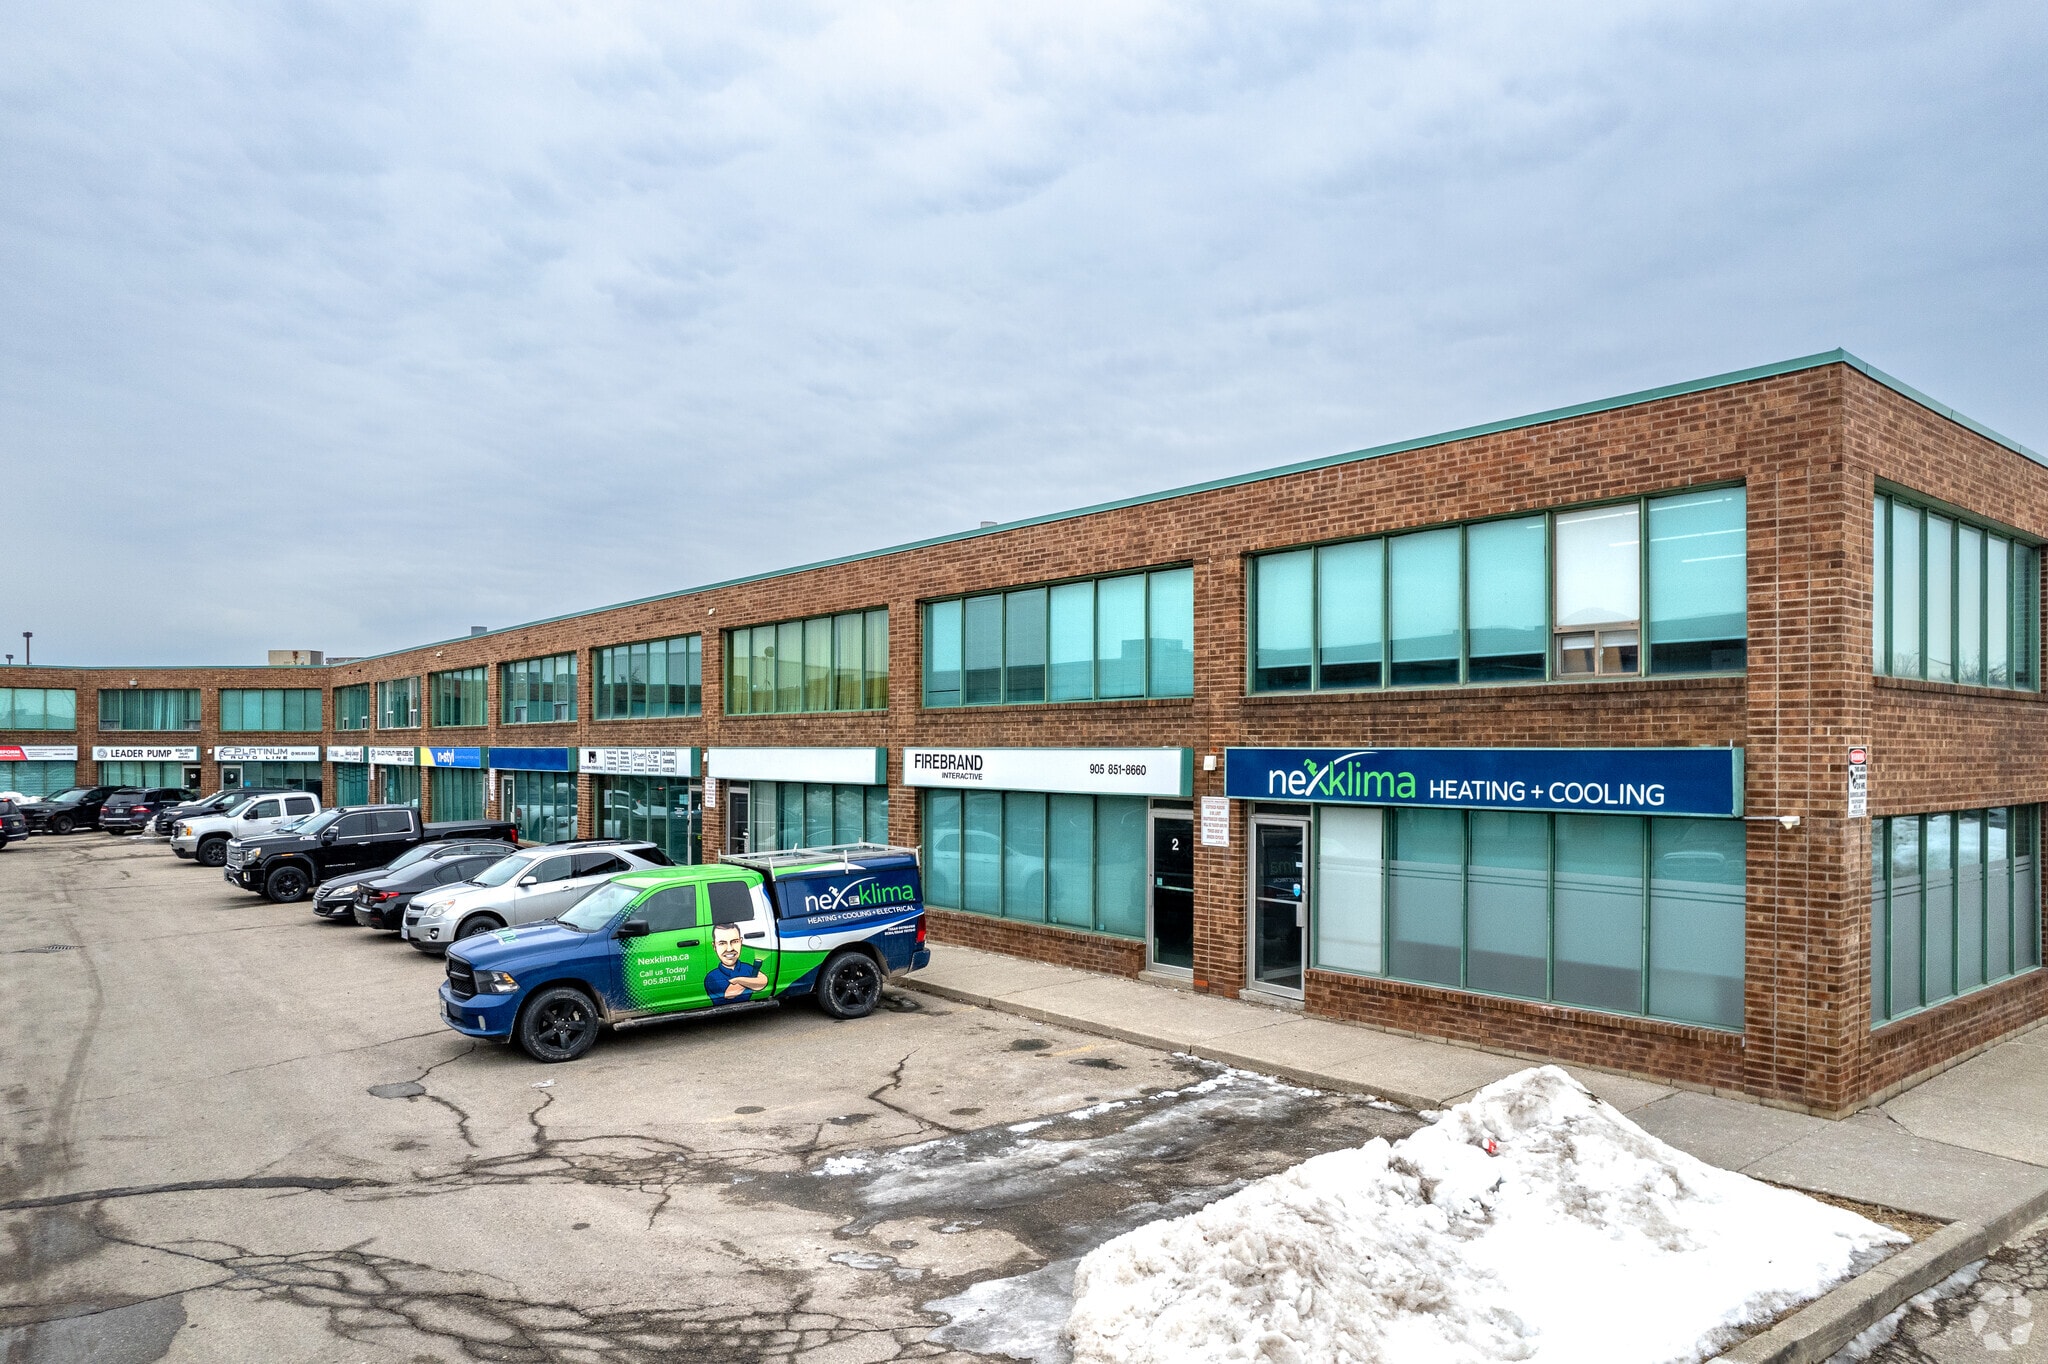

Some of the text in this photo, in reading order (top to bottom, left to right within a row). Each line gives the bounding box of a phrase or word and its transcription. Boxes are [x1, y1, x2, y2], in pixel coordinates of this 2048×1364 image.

[110, 749, 144, 758] LEADER
[147, 749, 172, 758] PUMP
[914, 753, 984, 771] FIREBRAND
[1090, 763, 1147, 775] 905 851-8660
[941, 772, 983, 780] INTERACTIVE
[1429, 779, 1526, 801] HEATING
[1549, 782, 1665, 806] COOLING
[1171, 837, 1179, 851] 2
[807, 914, 837, 924] HEATING
[842, 910, 872, 920] COOLING
[876, 905, 916, 915] ELECTRICAL
[638, 954, 690, 965] Nexklima.ca
[640, 970, 653, 978] Call
[643, 975, 686, 987] 905.851.7411
